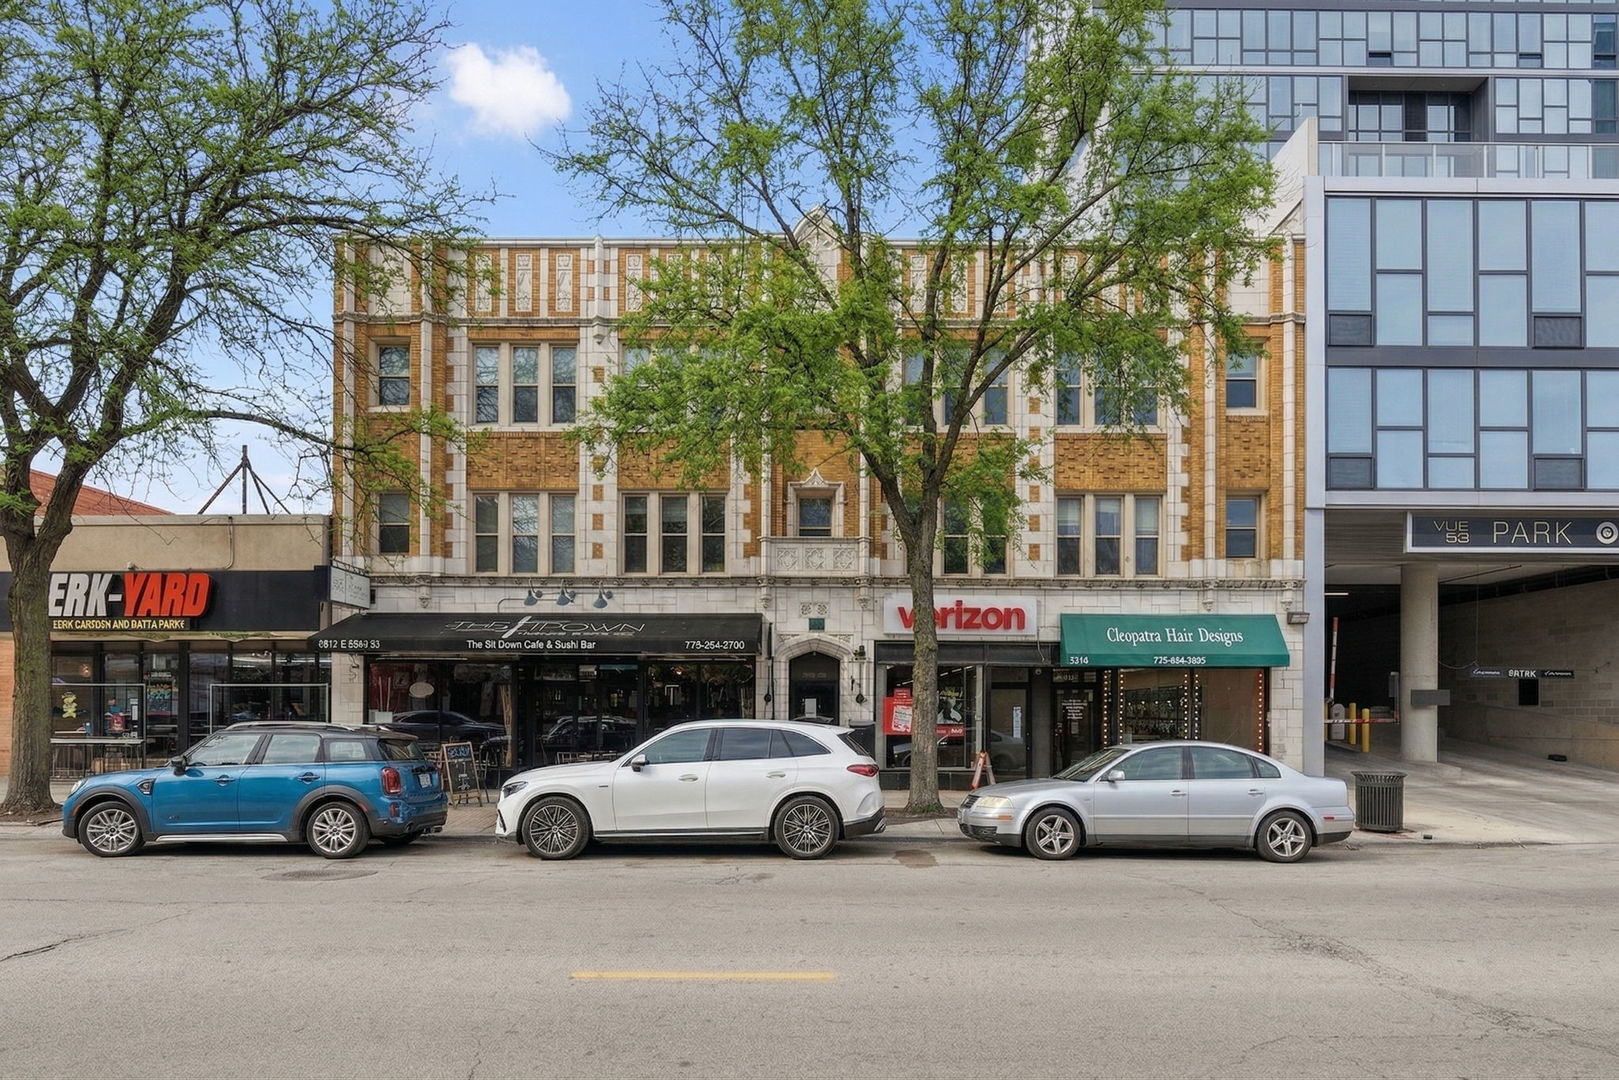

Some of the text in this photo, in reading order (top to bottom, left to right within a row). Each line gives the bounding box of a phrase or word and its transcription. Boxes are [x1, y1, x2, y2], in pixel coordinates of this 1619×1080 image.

[1433, 520, 1469, 532] VUE
[1445, 532, 1470, 543] 53
[1492, 521, 1572, 544] PARK
[897, 600, 1026, 630] vrizon
[112, 619, 130, 630] AND
[1106, 627, 1244, 647] Cleopatra Hair Designs
[340, 639, 347, 649] E
[466, 640, 483, 649] The
[498, 640, 522, 649] Down
[523, 640, 544, 649] Cafe
[546, 640, 553, 649] &
[554, 640, 579, 649] Sushi
[580, 640, 596, 649] Bar
